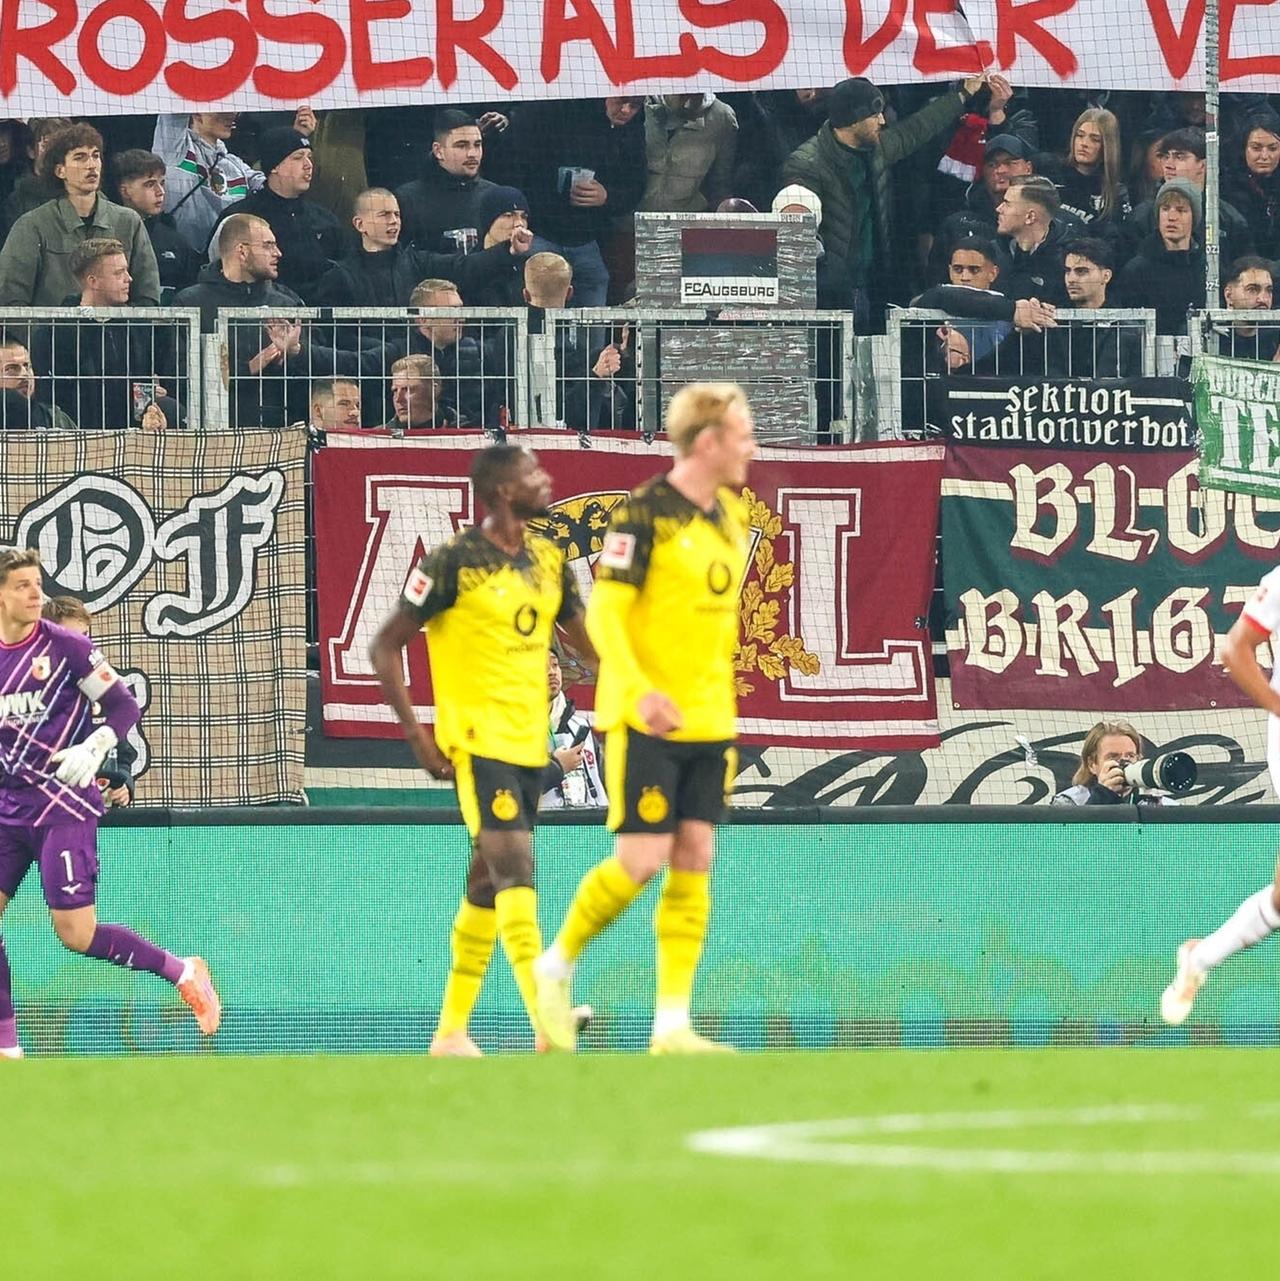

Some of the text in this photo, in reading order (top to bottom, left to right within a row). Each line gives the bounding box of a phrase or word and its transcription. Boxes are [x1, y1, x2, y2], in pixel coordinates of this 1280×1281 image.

[1006, 380, 1136, 416] sektion
[950, 410, 1191, 451] stadionverbot
[60, 851, 73, 882] 1
